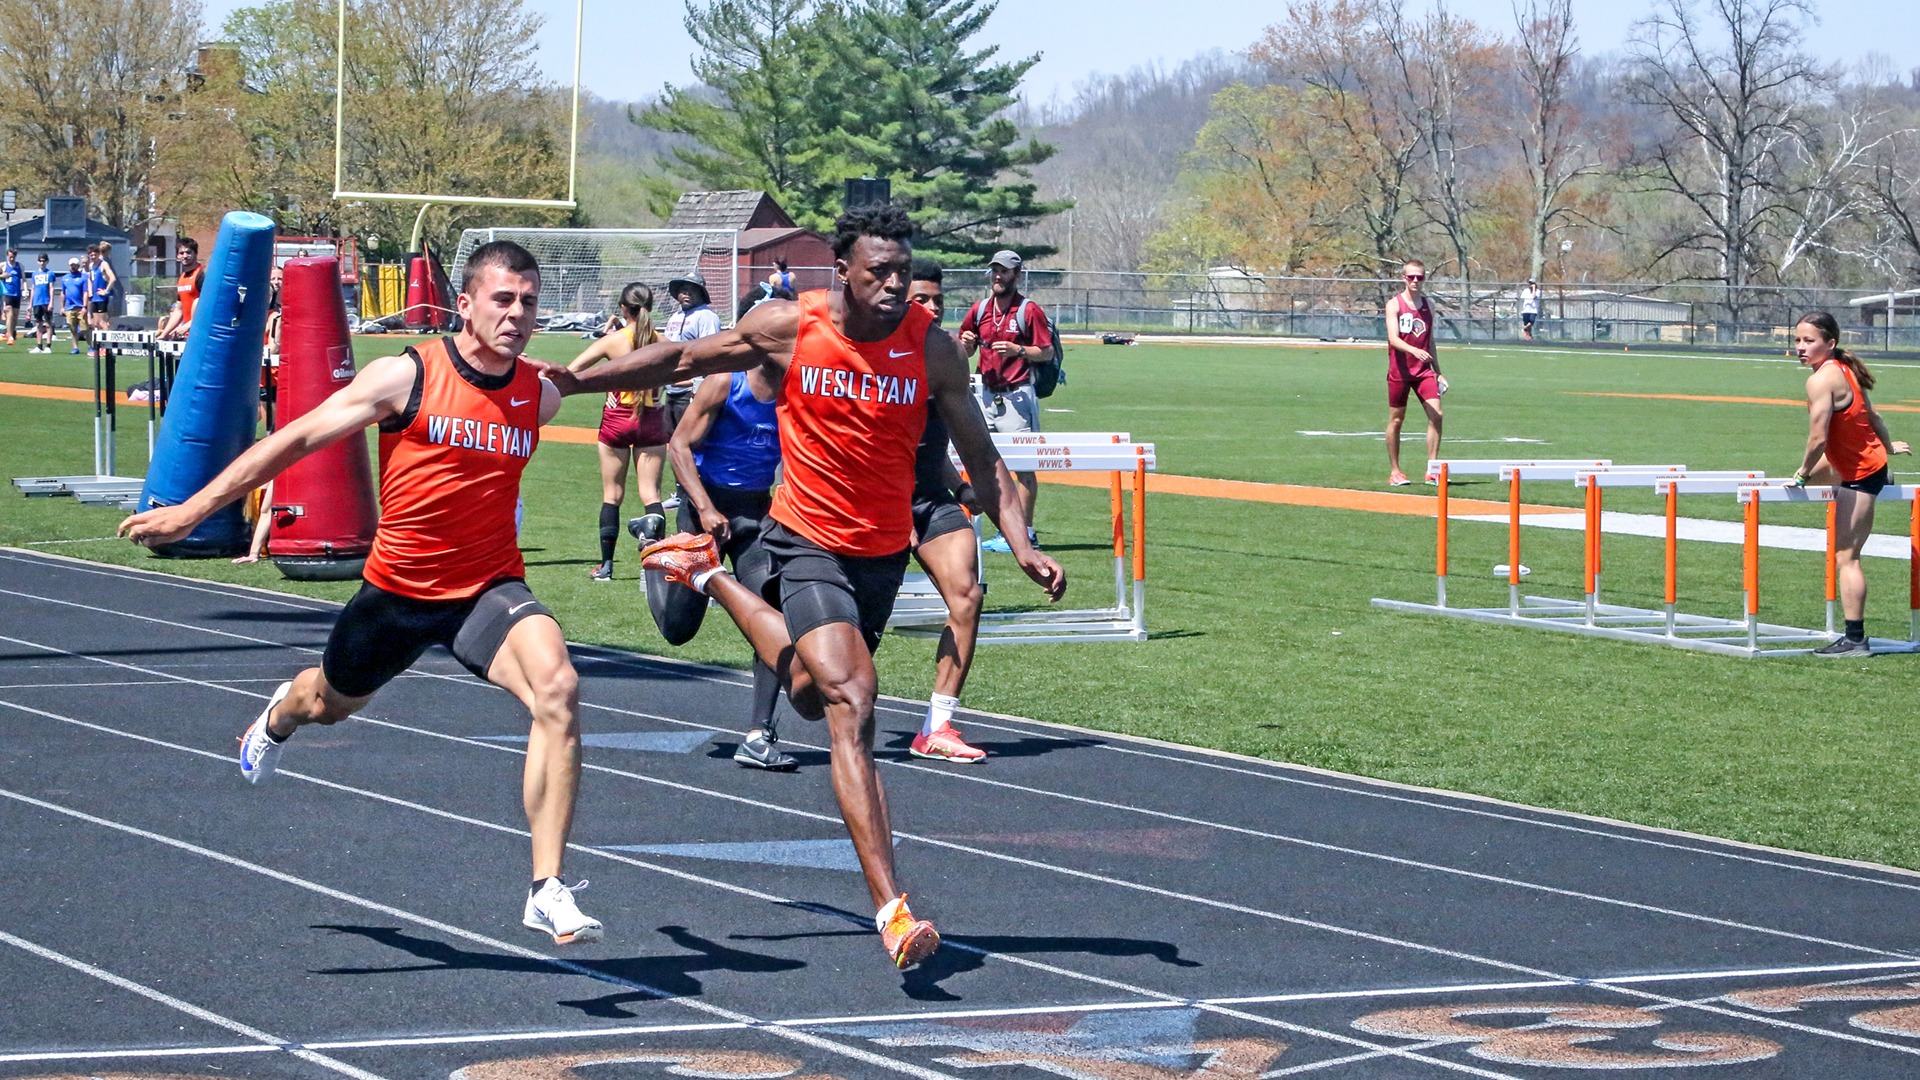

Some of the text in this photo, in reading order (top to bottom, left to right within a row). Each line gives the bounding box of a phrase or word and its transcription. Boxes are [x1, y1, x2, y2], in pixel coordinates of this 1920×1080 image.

[800, 364, 918, 406] WESLEYAN
[427, 414, 533, 459] WESLEYAN
[1012, 436, 1037, 444] WVWC
[1036, 448, 1062, 456] WVWC
[1038, 459, 1063, 469] WVWC
